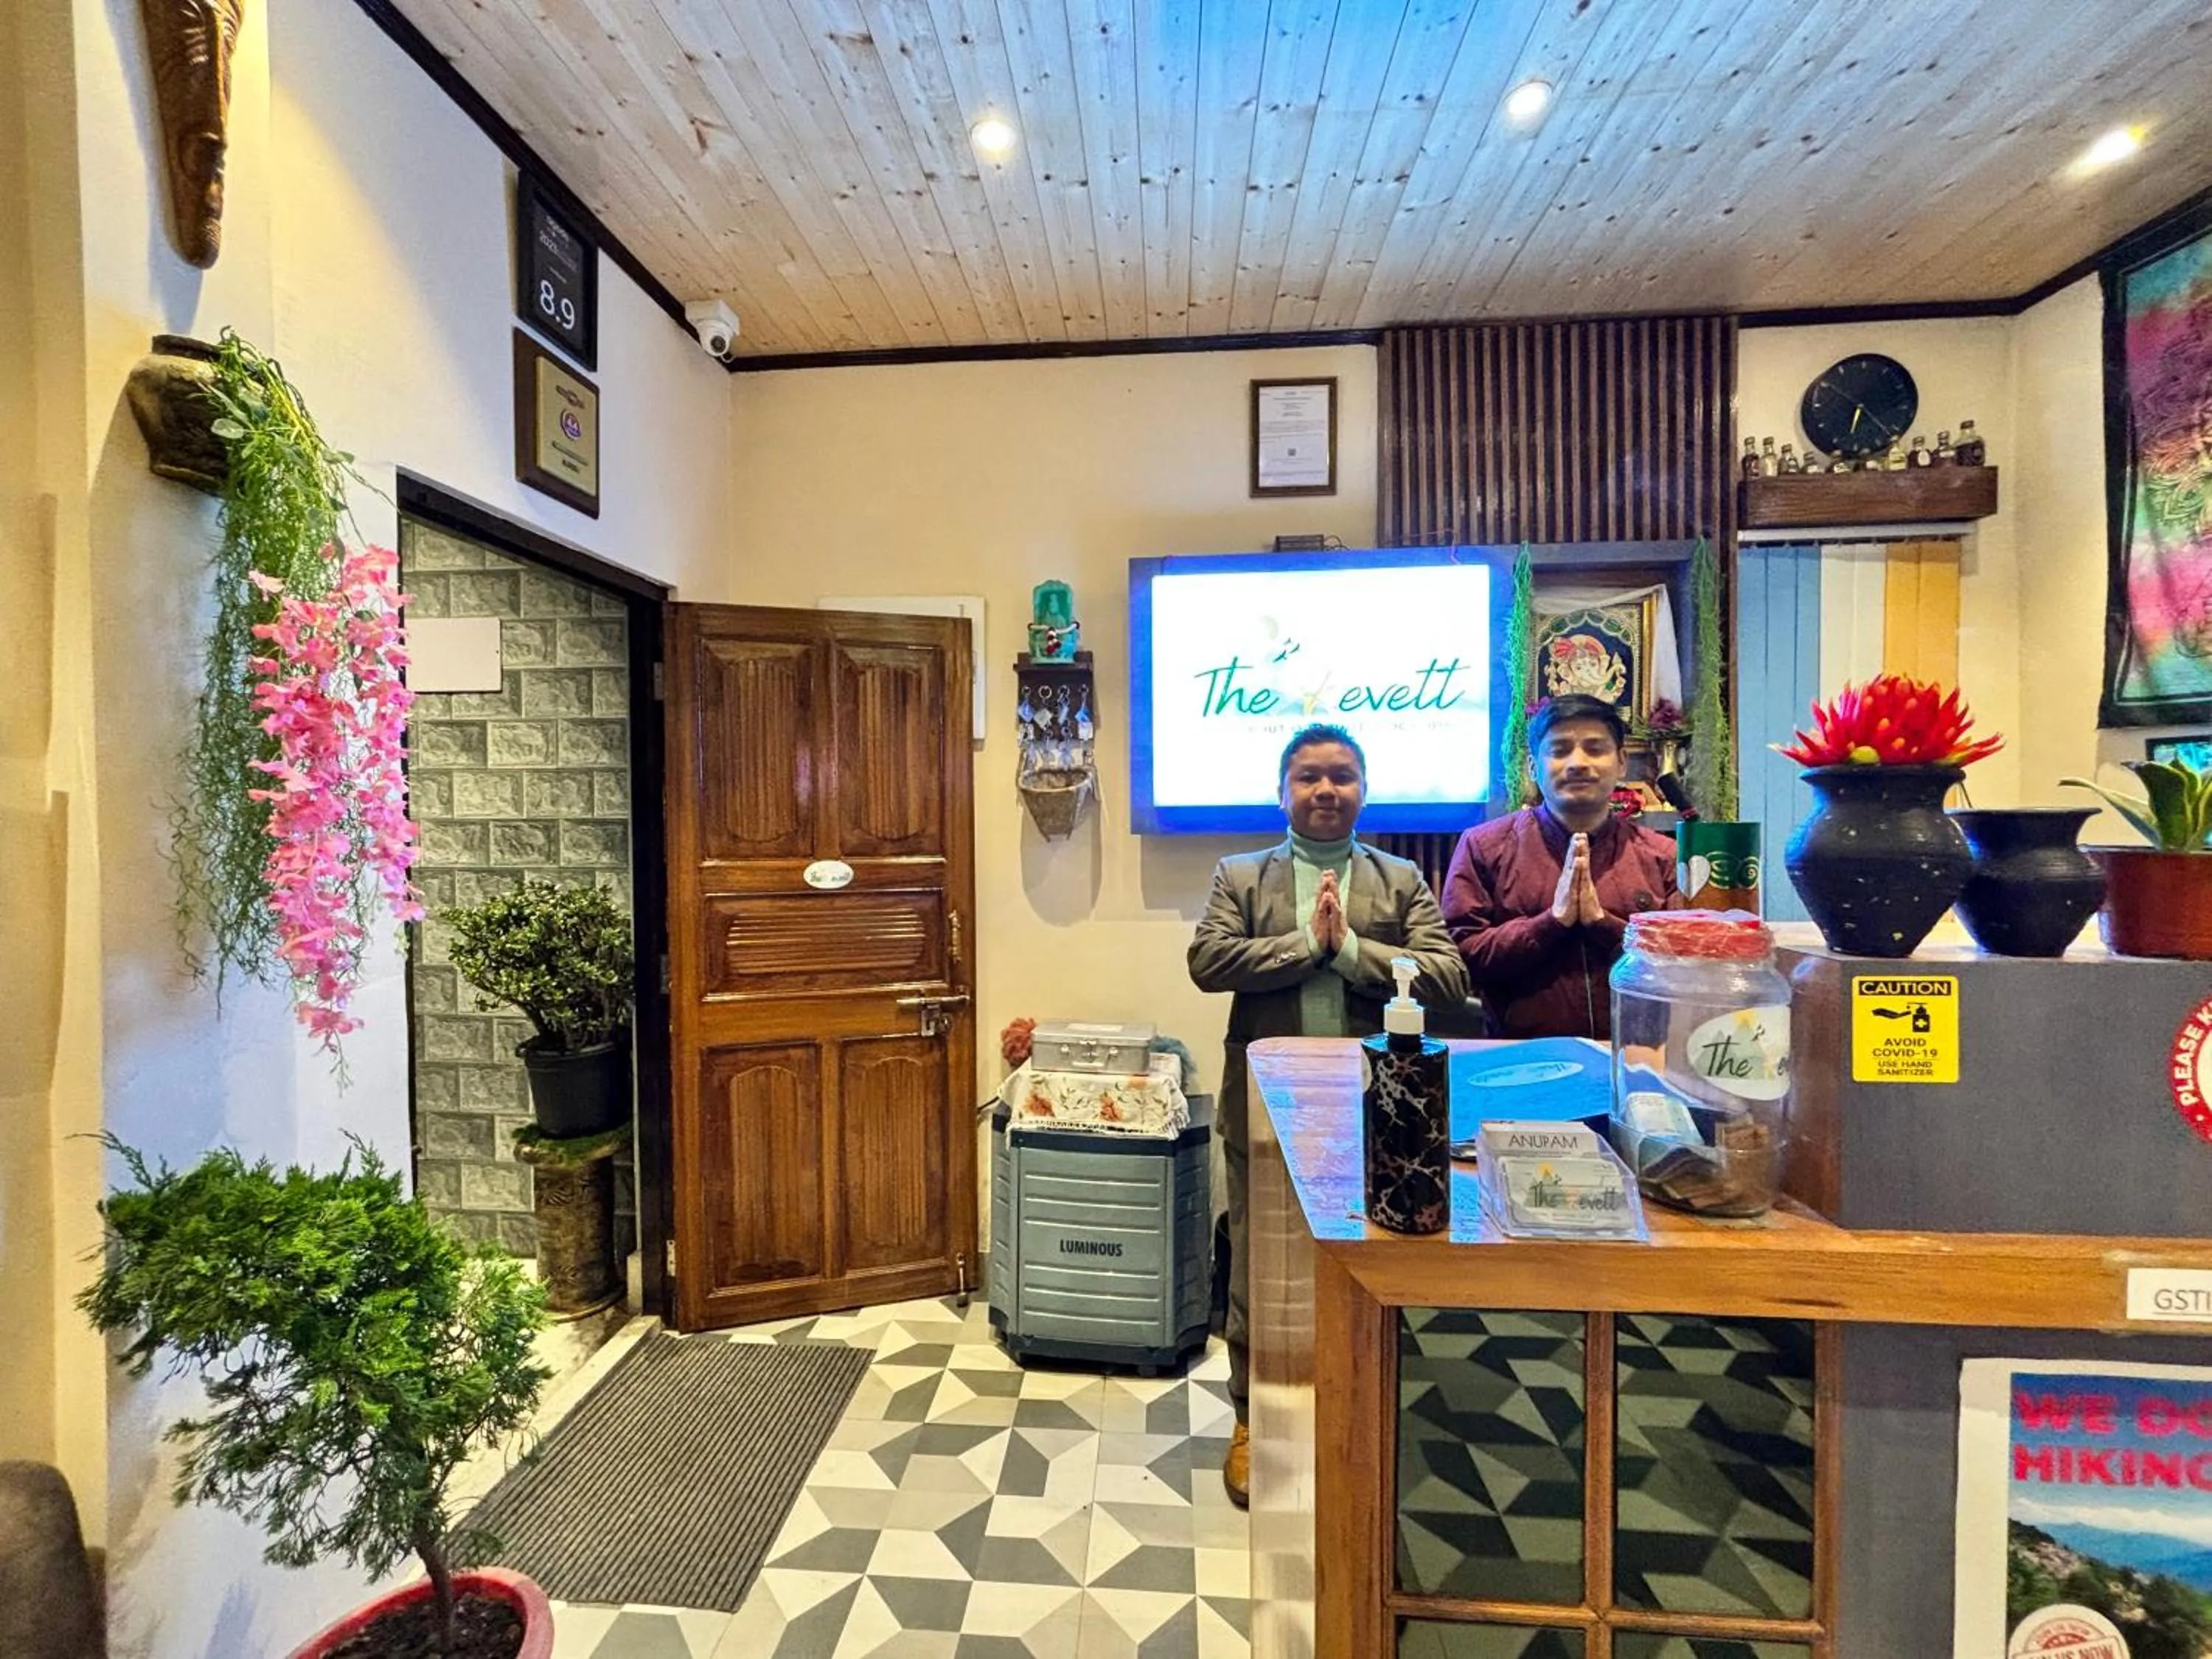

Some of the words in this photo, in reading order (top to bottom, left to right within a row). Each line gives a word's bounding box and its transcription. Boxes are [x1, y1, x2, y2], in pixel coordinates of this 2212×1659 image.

[540, 279, 575, 330] 8.9
[1194, 656, 1280, 717] The
[1862, 981, 1948, 995] CAUTION
[1884, 1037, 1927, 1047] AVOID
[1702, 1034, 1753, 1077] The
[1871, 1048, 1938, 1057] COVID-19
[1877, 1068, 1934, 1077] SANITIZER
[1901, 1060, 1933, 1068] HAND
[2174, 1023, 2204, 1107] PLEASE
[1508, 1133, 1579, 1150] ANUPAM
[1529, 1180, 1559, 1208] The
[1060, 1239, 1124, 1257] LUMINOUS
[2013, 1391, 2116, 1435] WE
